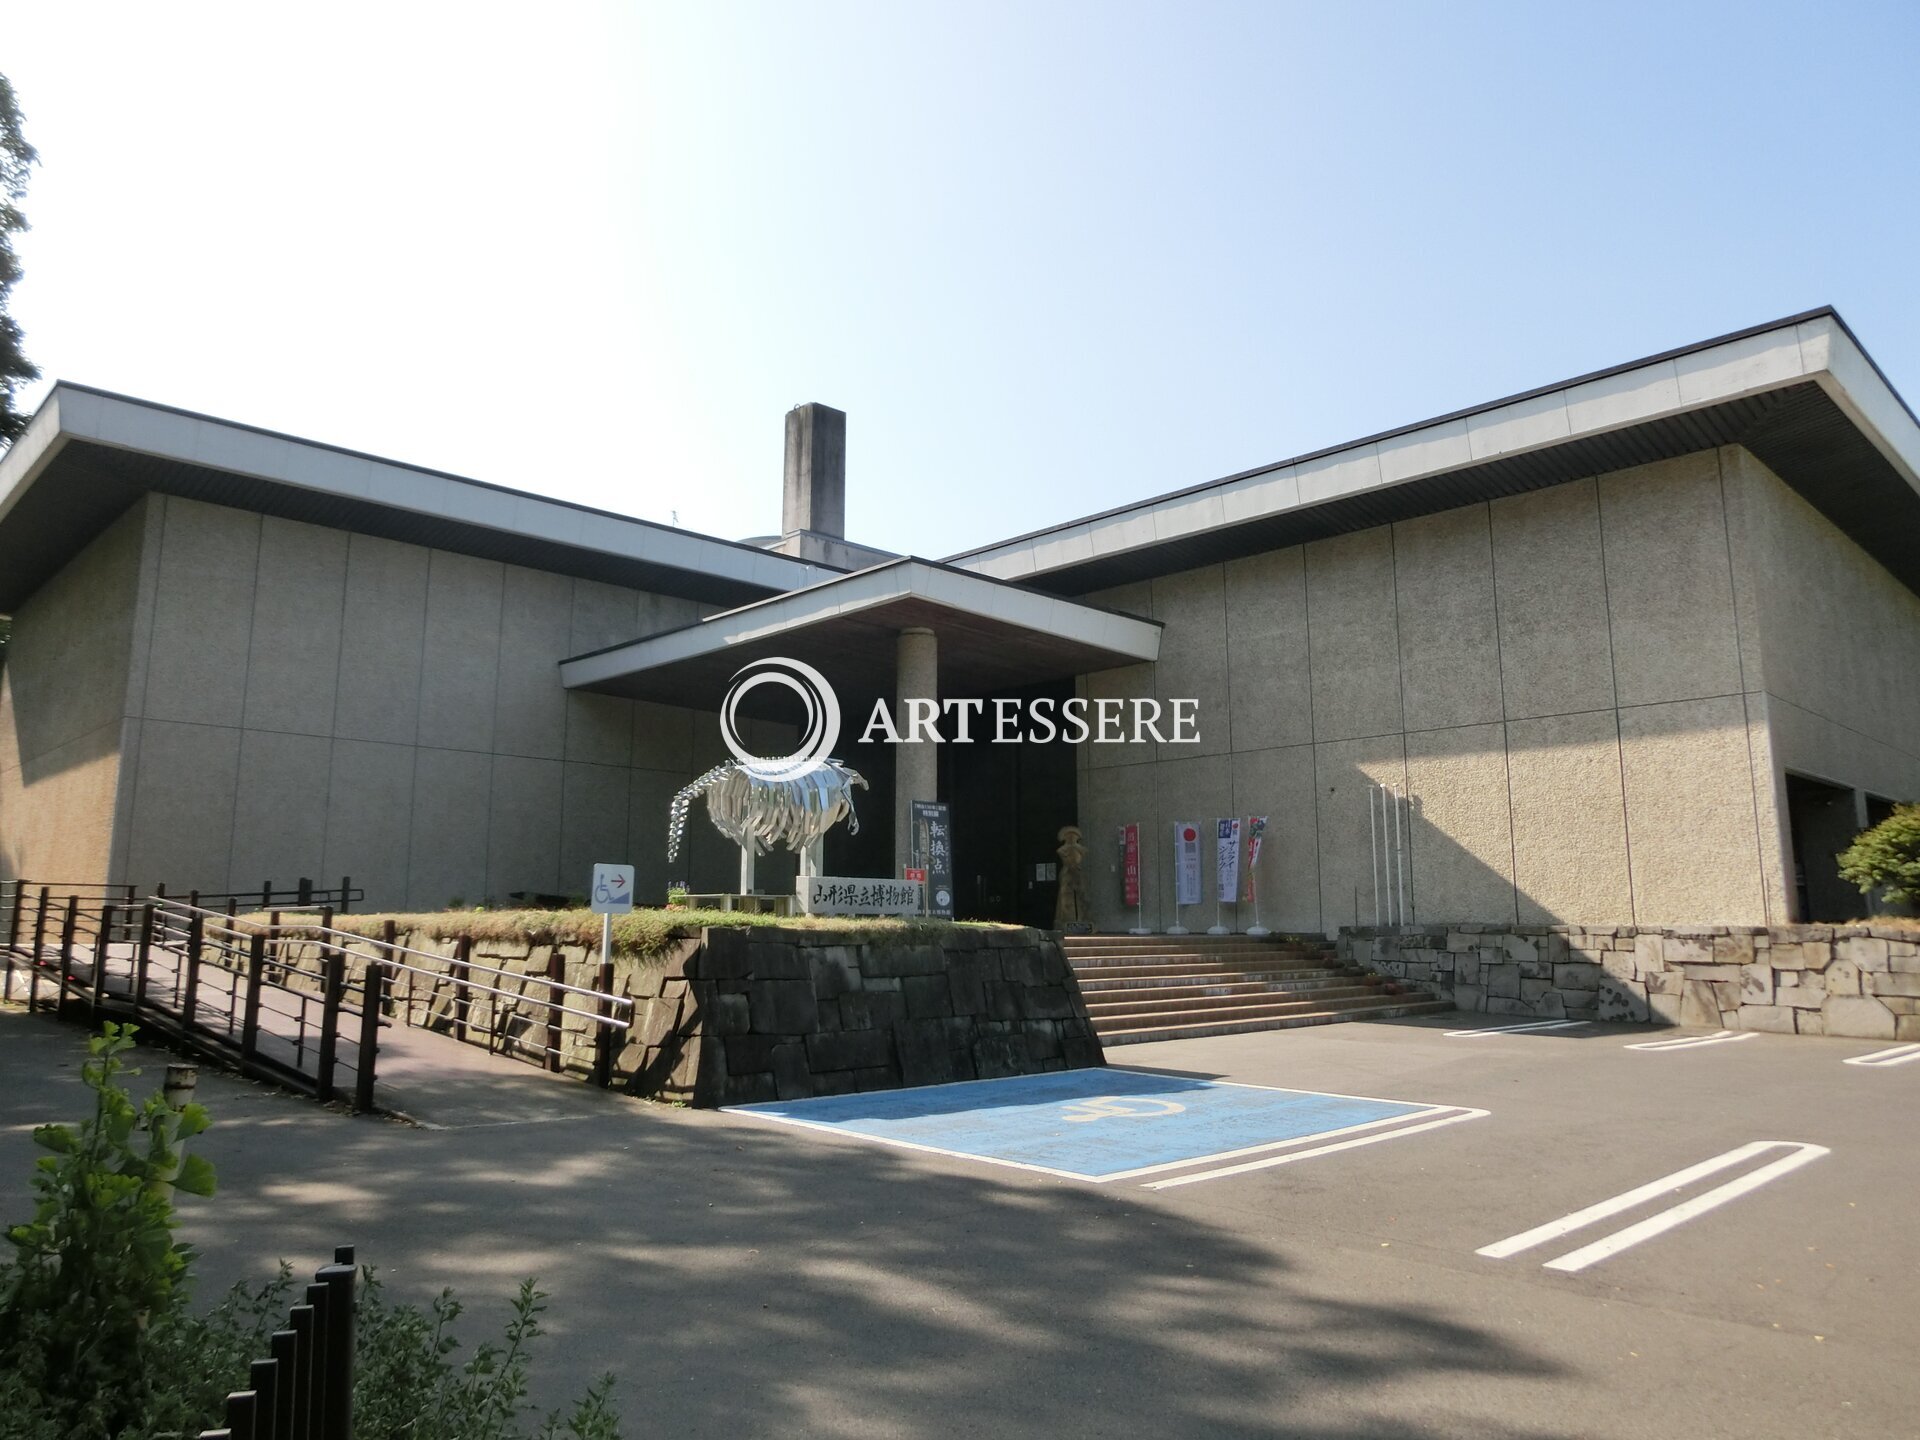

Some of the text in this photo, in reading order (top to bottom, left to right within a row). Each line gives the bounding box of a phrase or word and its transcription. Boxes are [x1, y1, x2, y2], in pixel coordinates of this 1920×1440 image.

[930, 821, 946, 875] 転換点
[813, 884, 915, 907] 山形県立博物館
